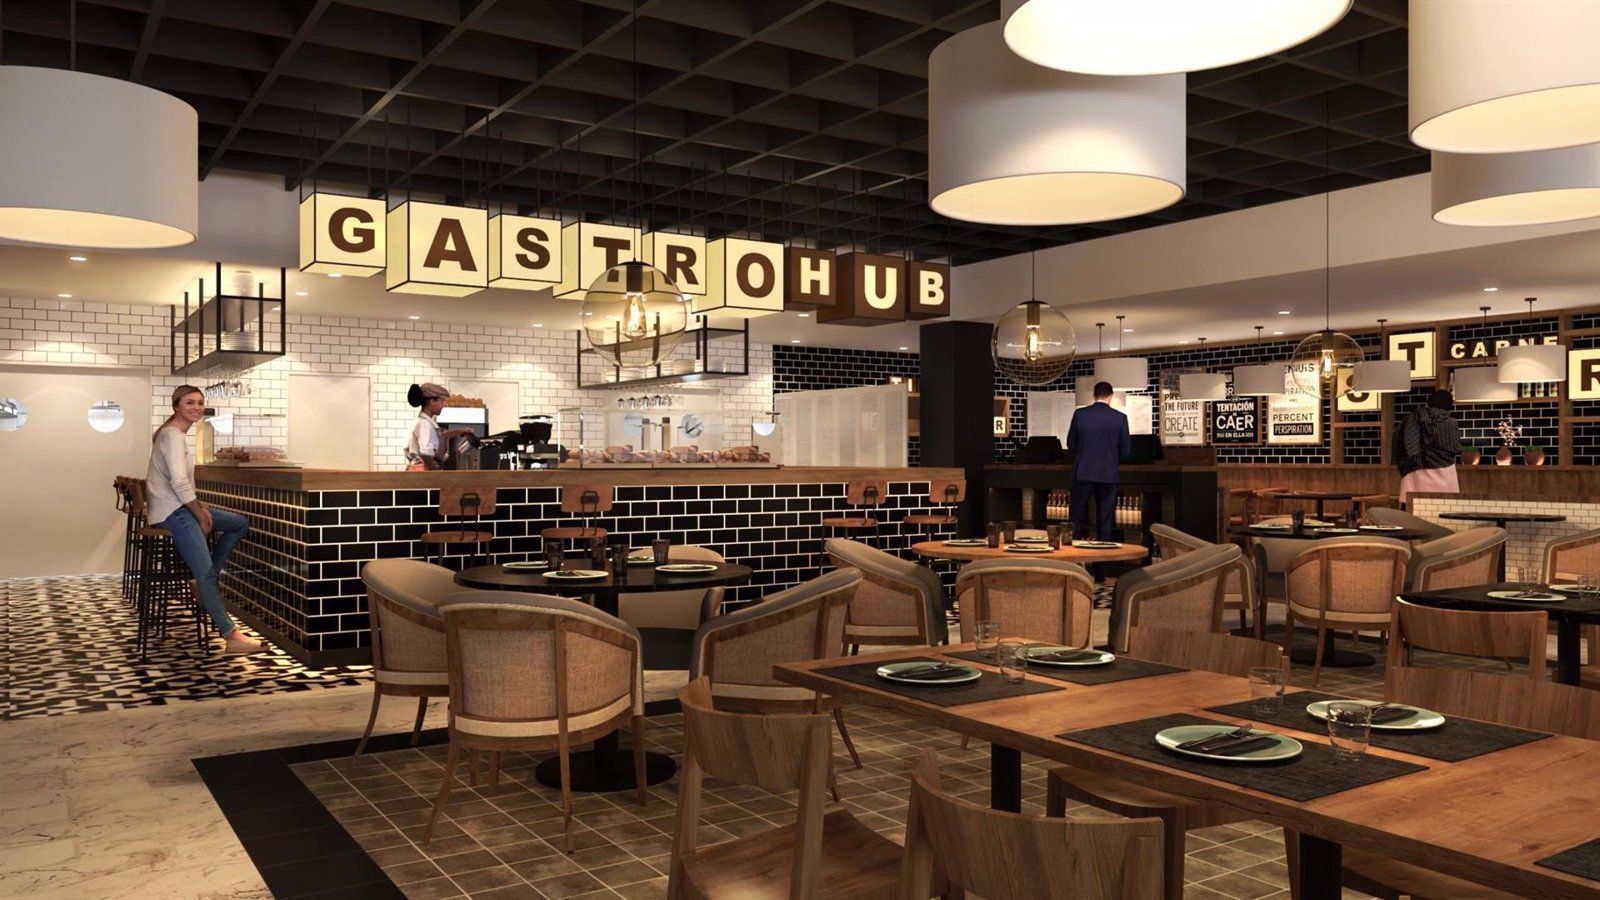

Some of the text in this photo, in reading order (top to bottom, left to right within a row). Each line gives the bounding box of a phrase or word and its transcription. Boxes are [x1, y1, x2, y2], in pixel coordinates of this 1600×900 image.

[1165, 401, 1199, 411] THE FUTURE
[1216, 401, 1254, 412] TENTACIÓN
[1273, 413, 1314, 421] PERCENT
[1165, 416, 1199, 431] CREATE
[1216, 414, 1254, 431] CAER
[1275, 425, 1312, 434] PERSPIRATION
